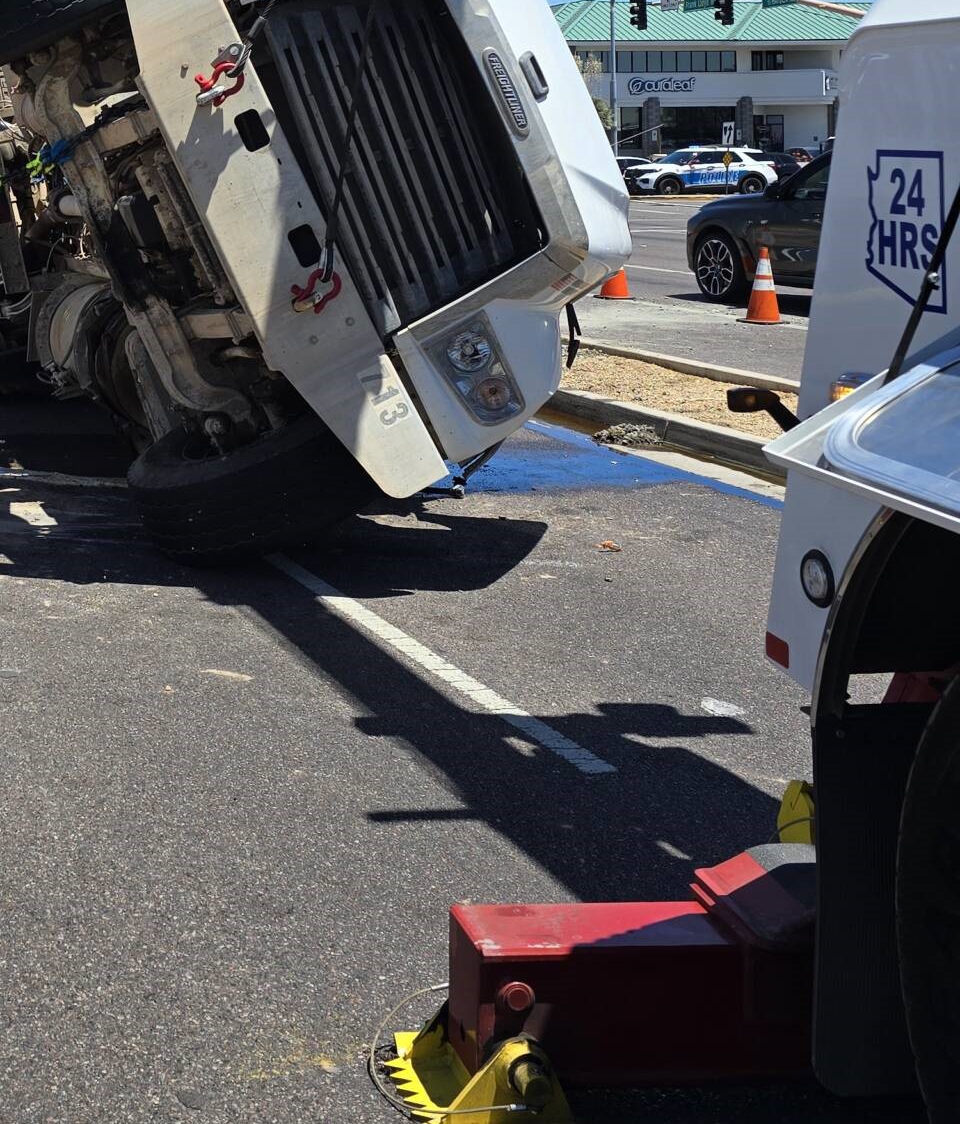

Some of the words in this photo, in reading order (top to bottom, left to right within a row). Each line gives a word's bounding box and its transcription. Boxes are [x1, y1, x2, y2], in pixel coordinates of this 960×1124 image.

[488, 55, 527, 128] FREIGHTLINER
[644, 76, 696, 93] curaleaf
[889, 167, 925, 217] 24
[878, 219, 938, 271] HRS
